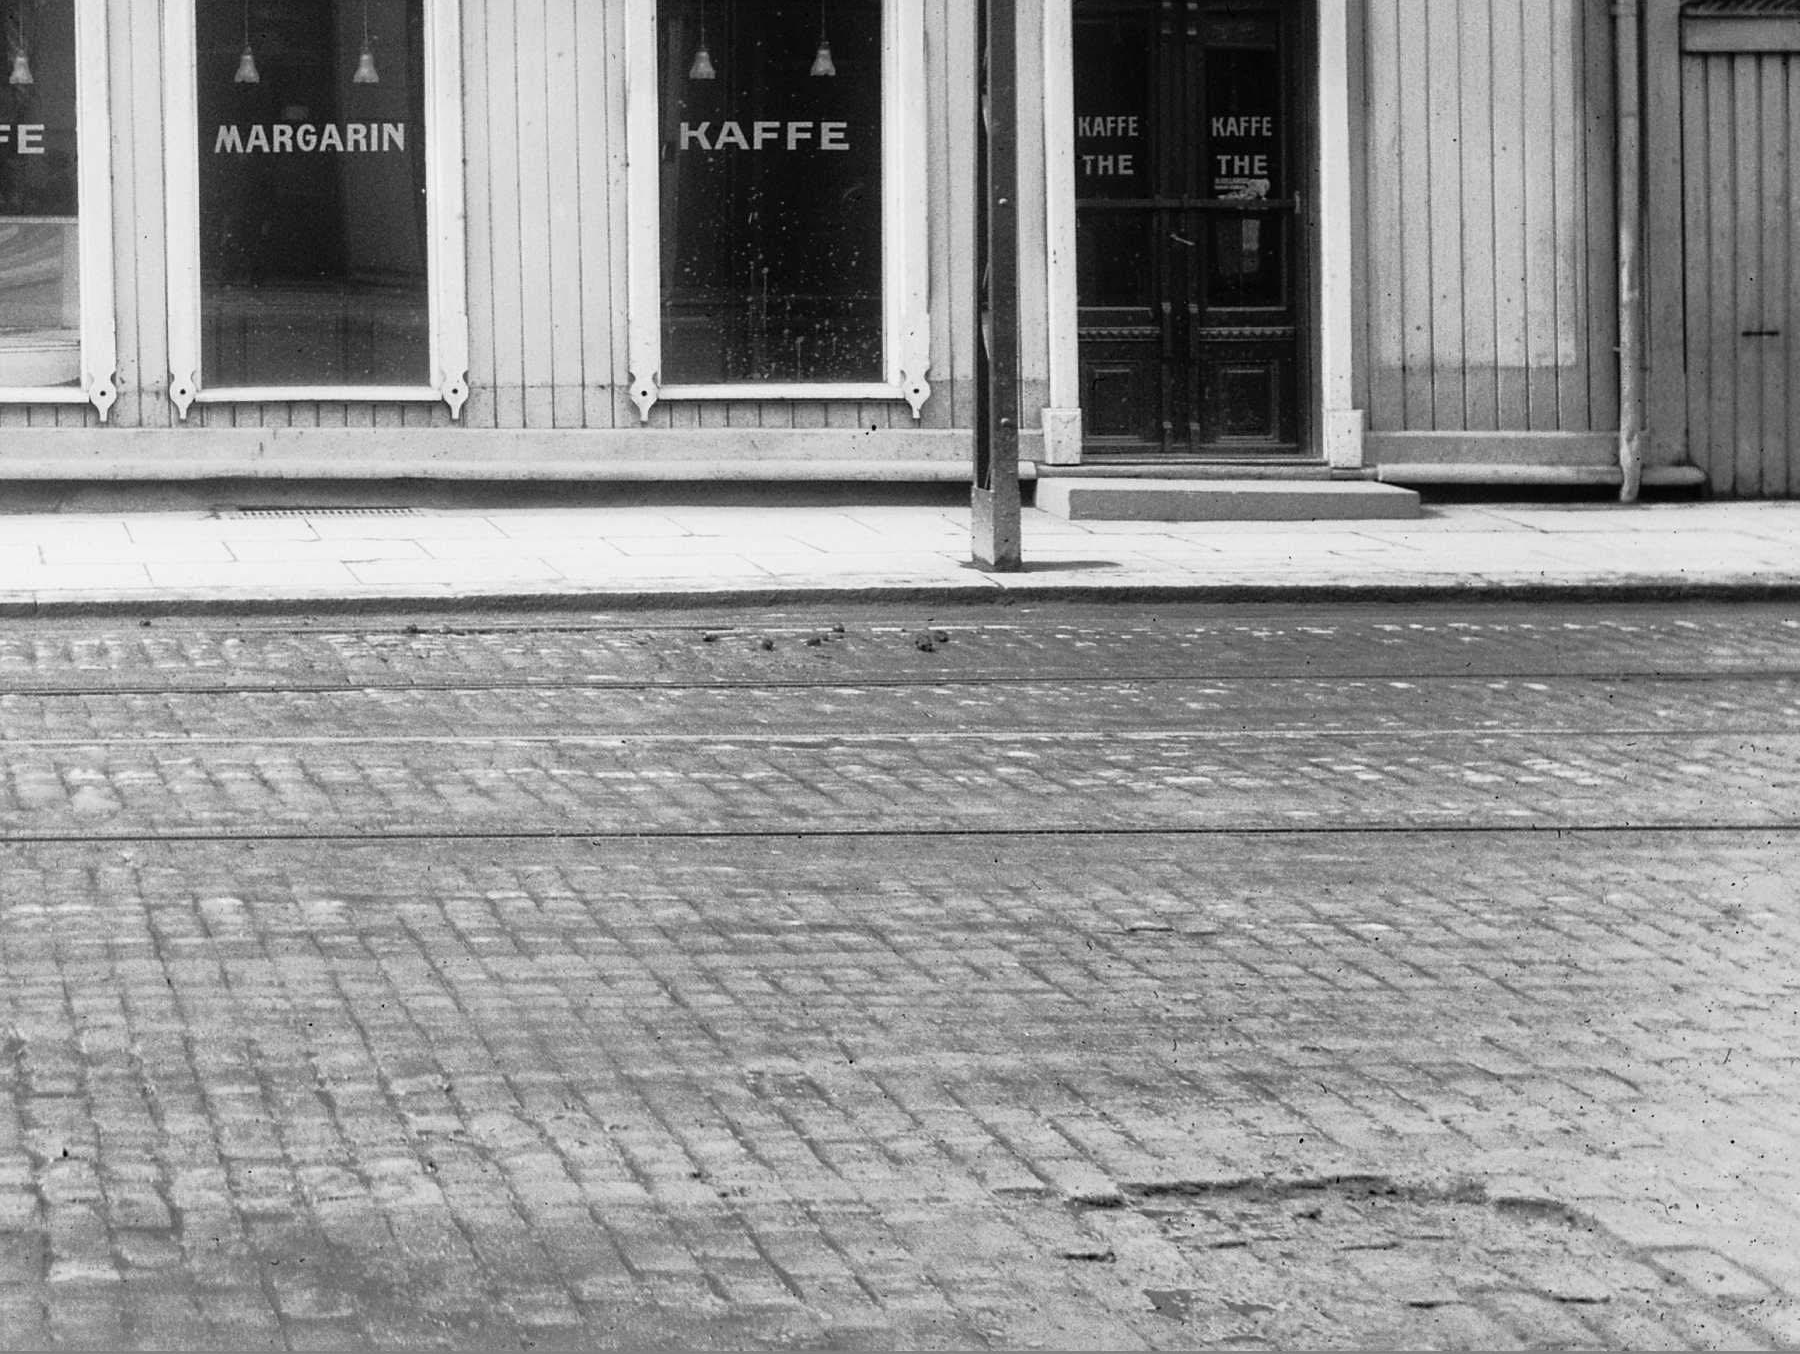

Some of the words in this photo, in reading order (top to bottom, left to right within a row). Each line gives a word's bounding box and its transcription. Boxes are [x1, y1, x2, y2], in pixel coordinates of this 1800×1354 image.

[679, 121, 851, 151] KAFFE
[1078, 116, 1139, 137] KAFFE
[1211, 116, 1273, 137] KAFFE
[214, 122, 406, 154] MARGARIN
[1082, 154, 1134, 175] THE
[1216, 154, 1268, 175] THE
